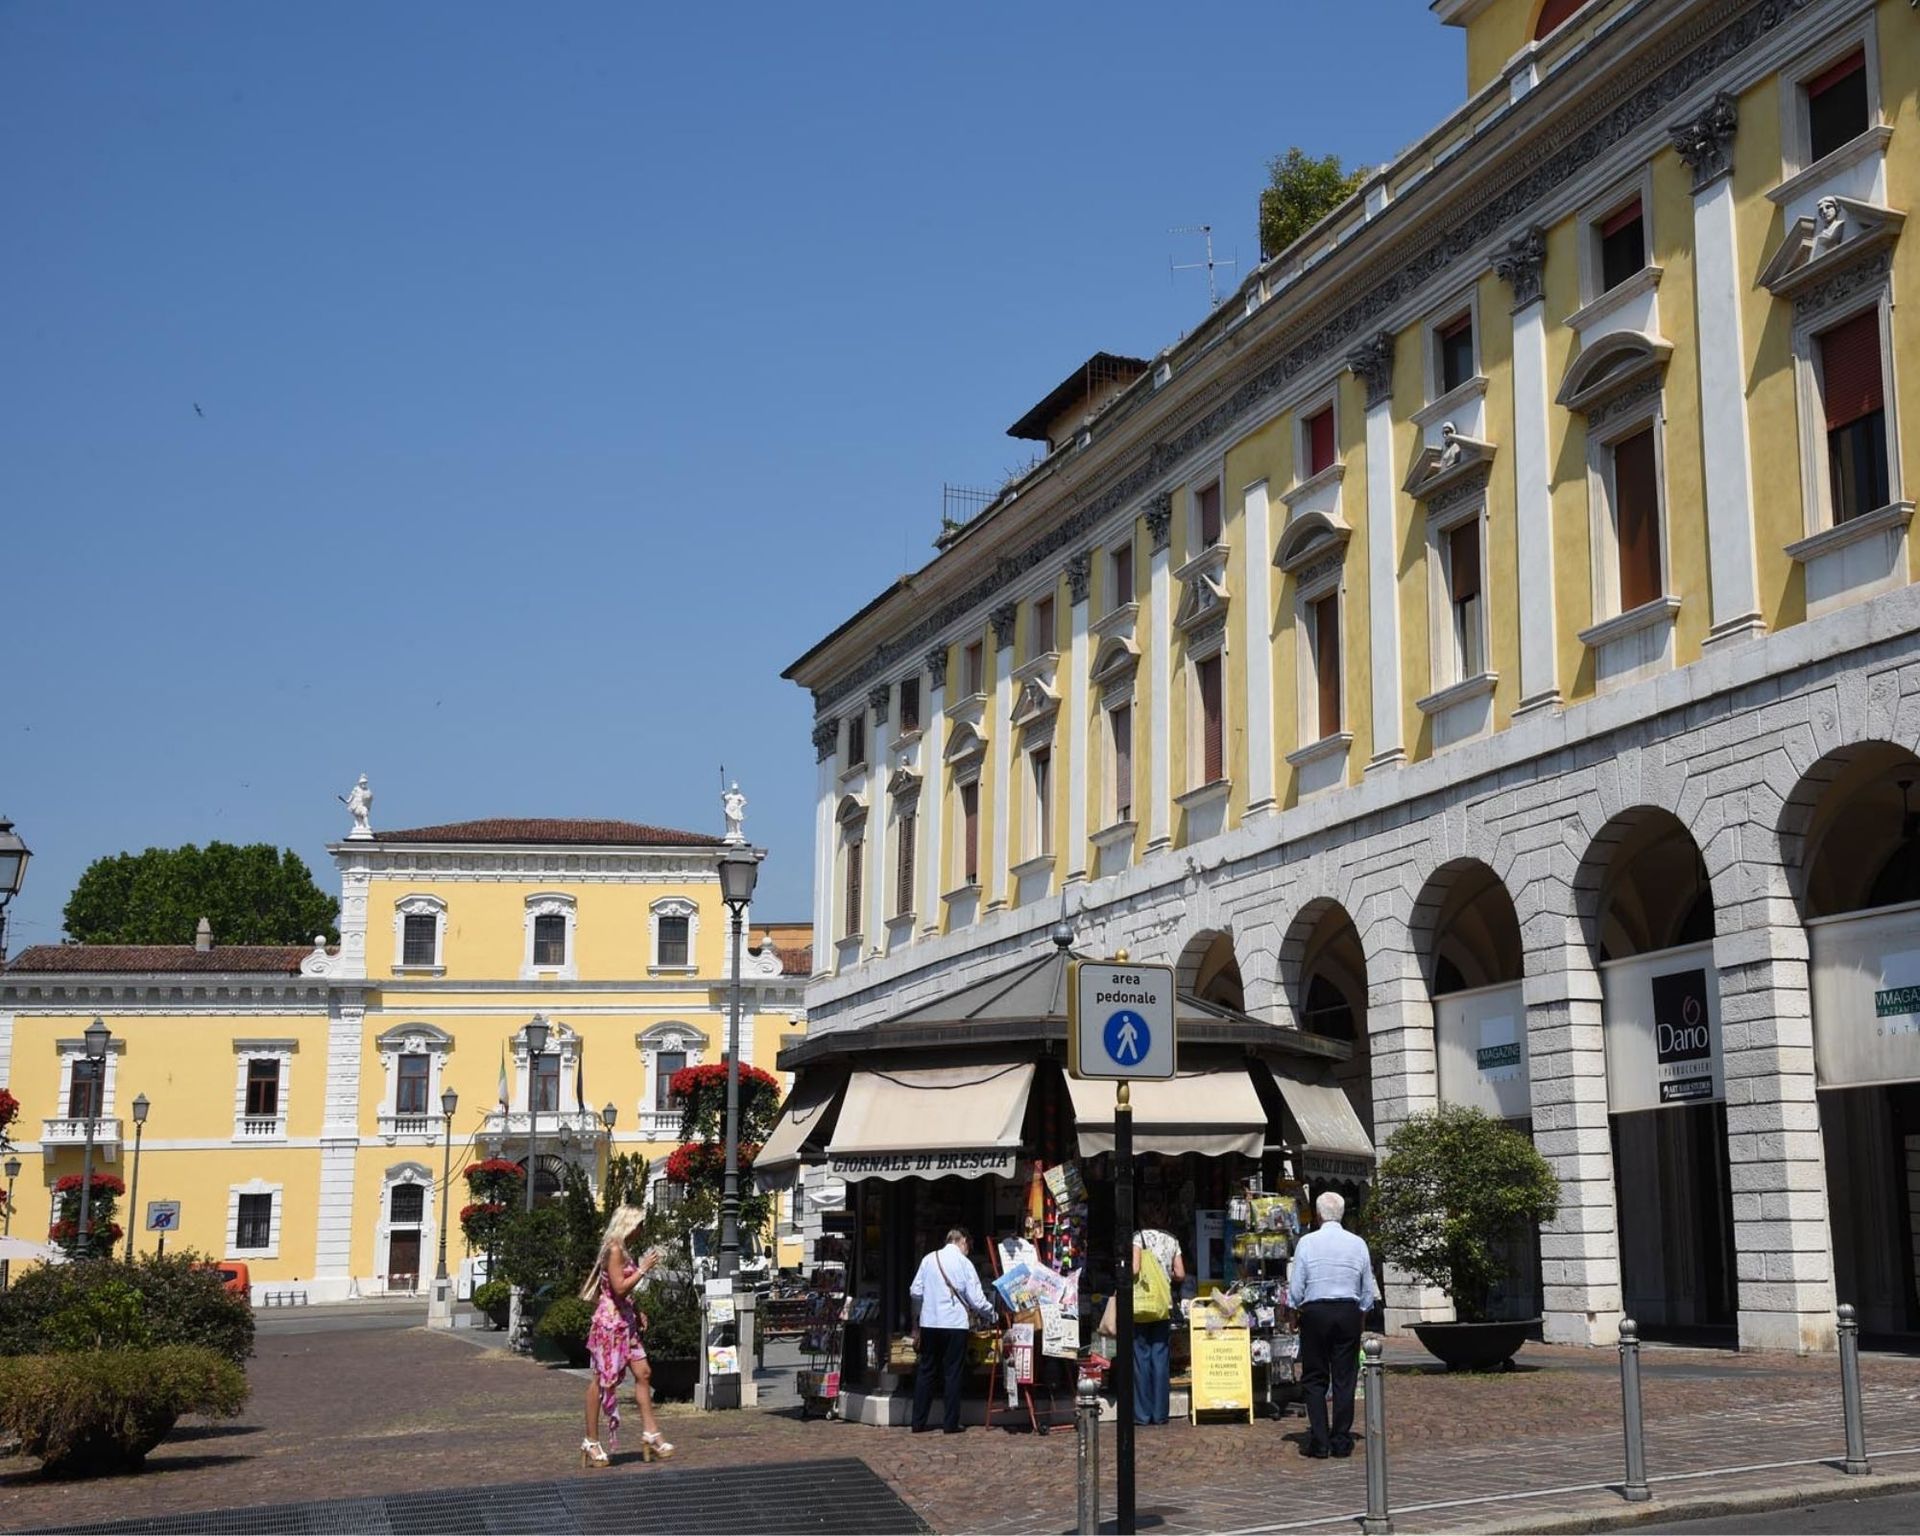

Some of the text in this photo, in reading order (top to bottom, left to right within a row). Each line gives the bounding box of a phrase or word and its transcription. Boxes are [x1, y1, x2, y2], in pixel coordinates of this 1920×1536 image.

[1112, 974, 1140, 985] area
[1096, 990, 1156, 1004] pedonale
[1875, 987, 1920, 1006] VMAGA
[1657, 1023, 1708, 1054] Dario
[832, 1151, 1008, 1173] GIORNALE DI BRESCIA
